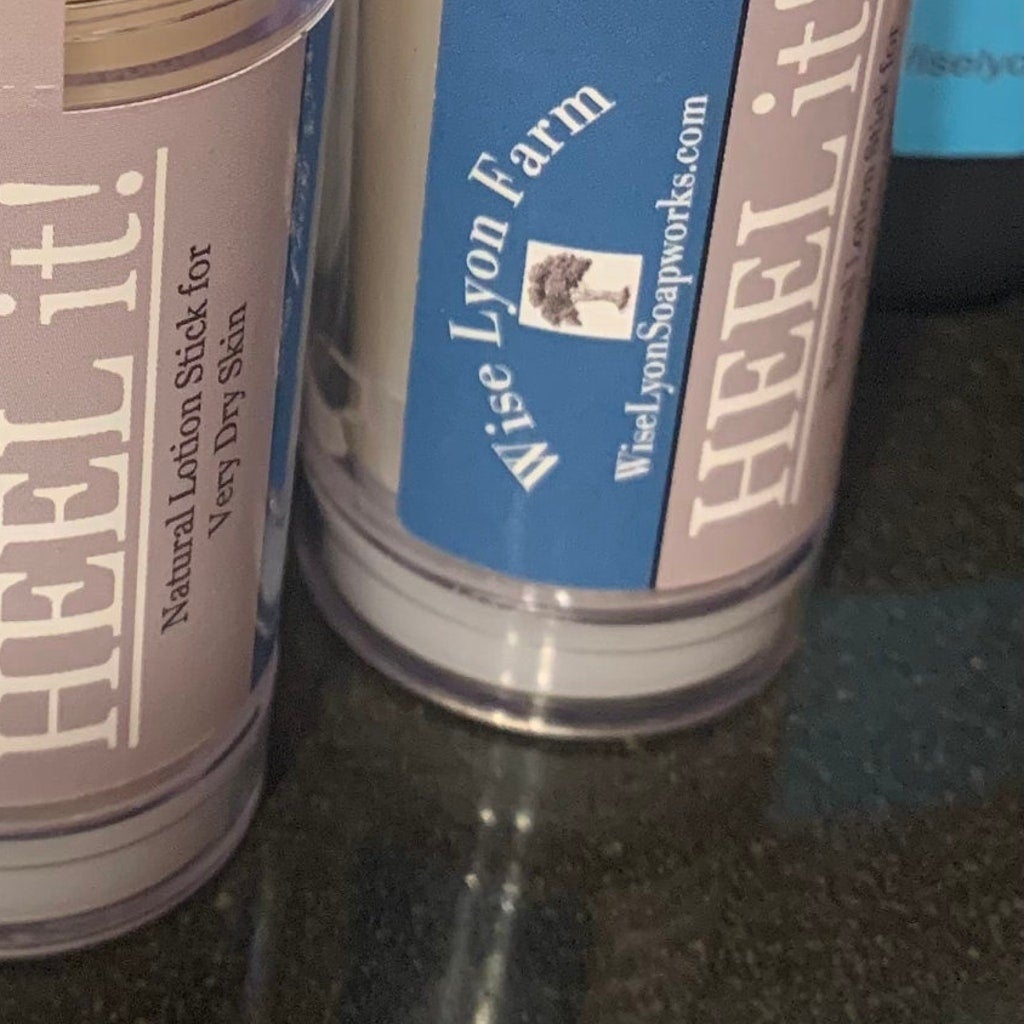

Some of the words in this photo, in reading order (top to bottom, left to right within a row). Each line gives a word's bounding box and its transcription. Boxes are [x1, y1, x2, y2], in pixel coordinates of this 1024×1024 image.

[466, 84, 618, 209] Farm
[176, 242, 212, 298] for
[448, 214, 519, 349] Lyon
[613, 94, 710, 483] WiseLyonSoapworks.com
[173, 299, 209, 390] Stick
[217, 301, 249, 387] Skin
[688, 135, 848, 540] HEEL
[167, 391, 203, 508] Lotion
[213, 390, 247, 457] Dry
[479, 362, 561, 494] Wise
[208, 458, 242, 540] Very
[161, 506, 196, 636] Natural
